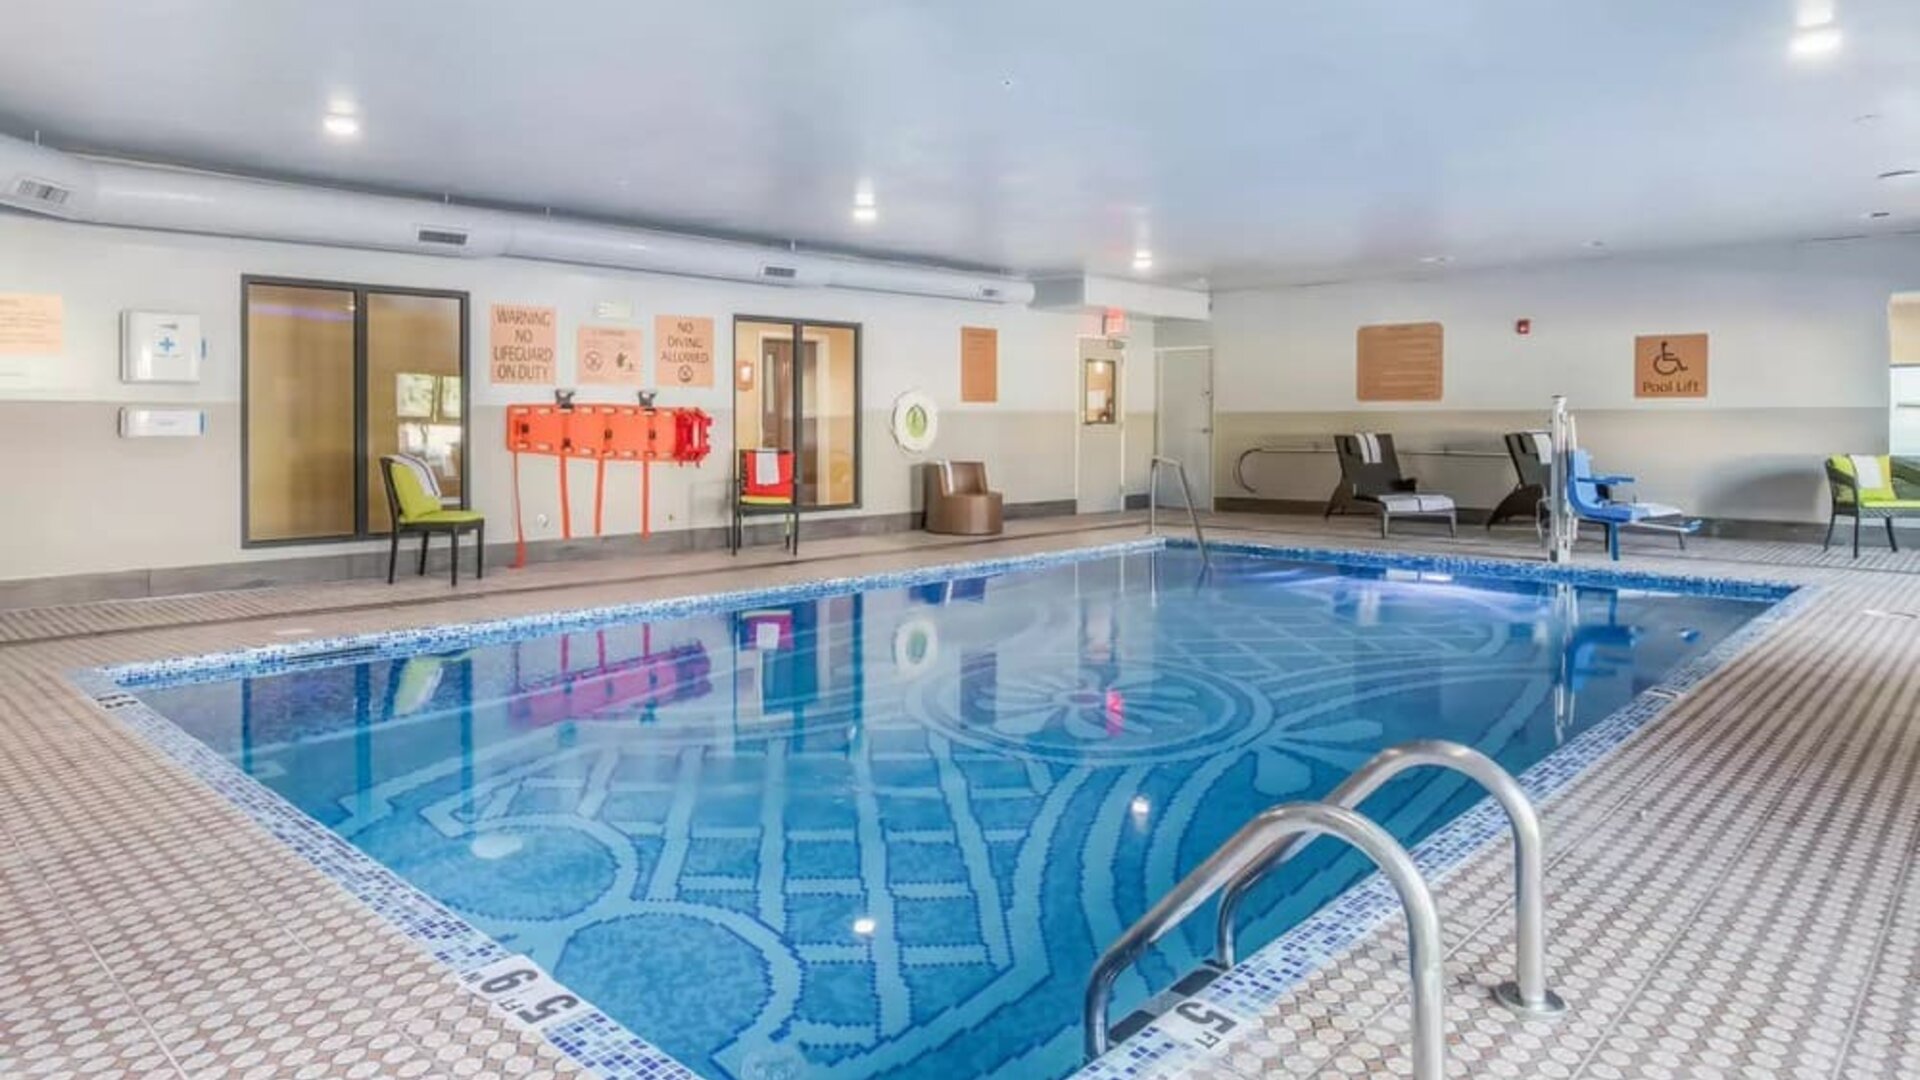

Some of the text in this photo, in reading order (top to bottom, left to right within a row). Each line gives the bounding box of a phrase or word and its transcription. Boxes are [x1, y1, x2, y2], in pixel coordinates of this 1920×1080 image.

[496, 308, 551, 327] WARNING
[678, 321, 694, 334] NO
[514, 329, 533, 343] NO
[667, 335, 703, 348] DIVING
[493, 345, 554, 362] LIFEGUARD
[660, 351, 709, 363] ALLOWED
[497, 363, 548, 380] ON DUTY
[1642, 379, 1699, 392] Pool Lift
[1175, 1002, 1237, 1034] 5
